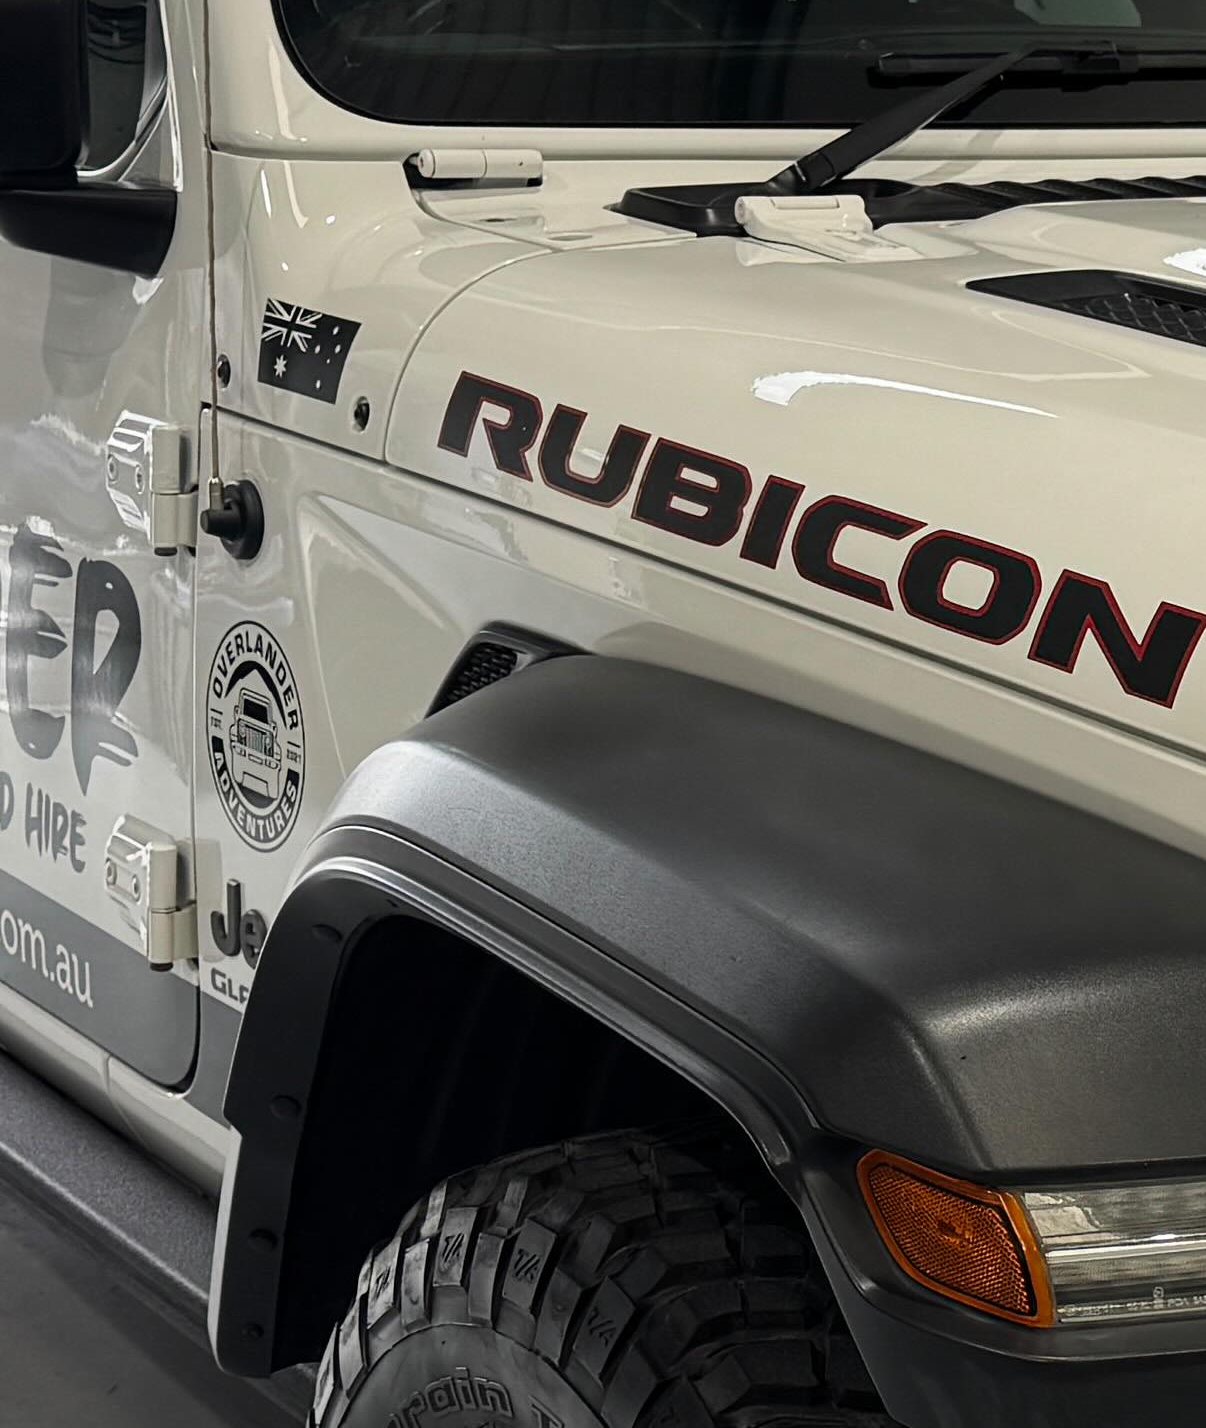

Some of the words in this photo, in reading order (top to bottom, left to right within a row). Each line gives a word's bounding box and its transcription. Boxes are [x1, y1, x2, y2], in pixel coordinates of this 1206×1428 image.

[212, 630, 299, 731] OVERLANDER
[25, 781, 87, 873] HIRE
[214, 751, 297, 841] ADVENTURES
[0, 909, 93, 1009] om.au
